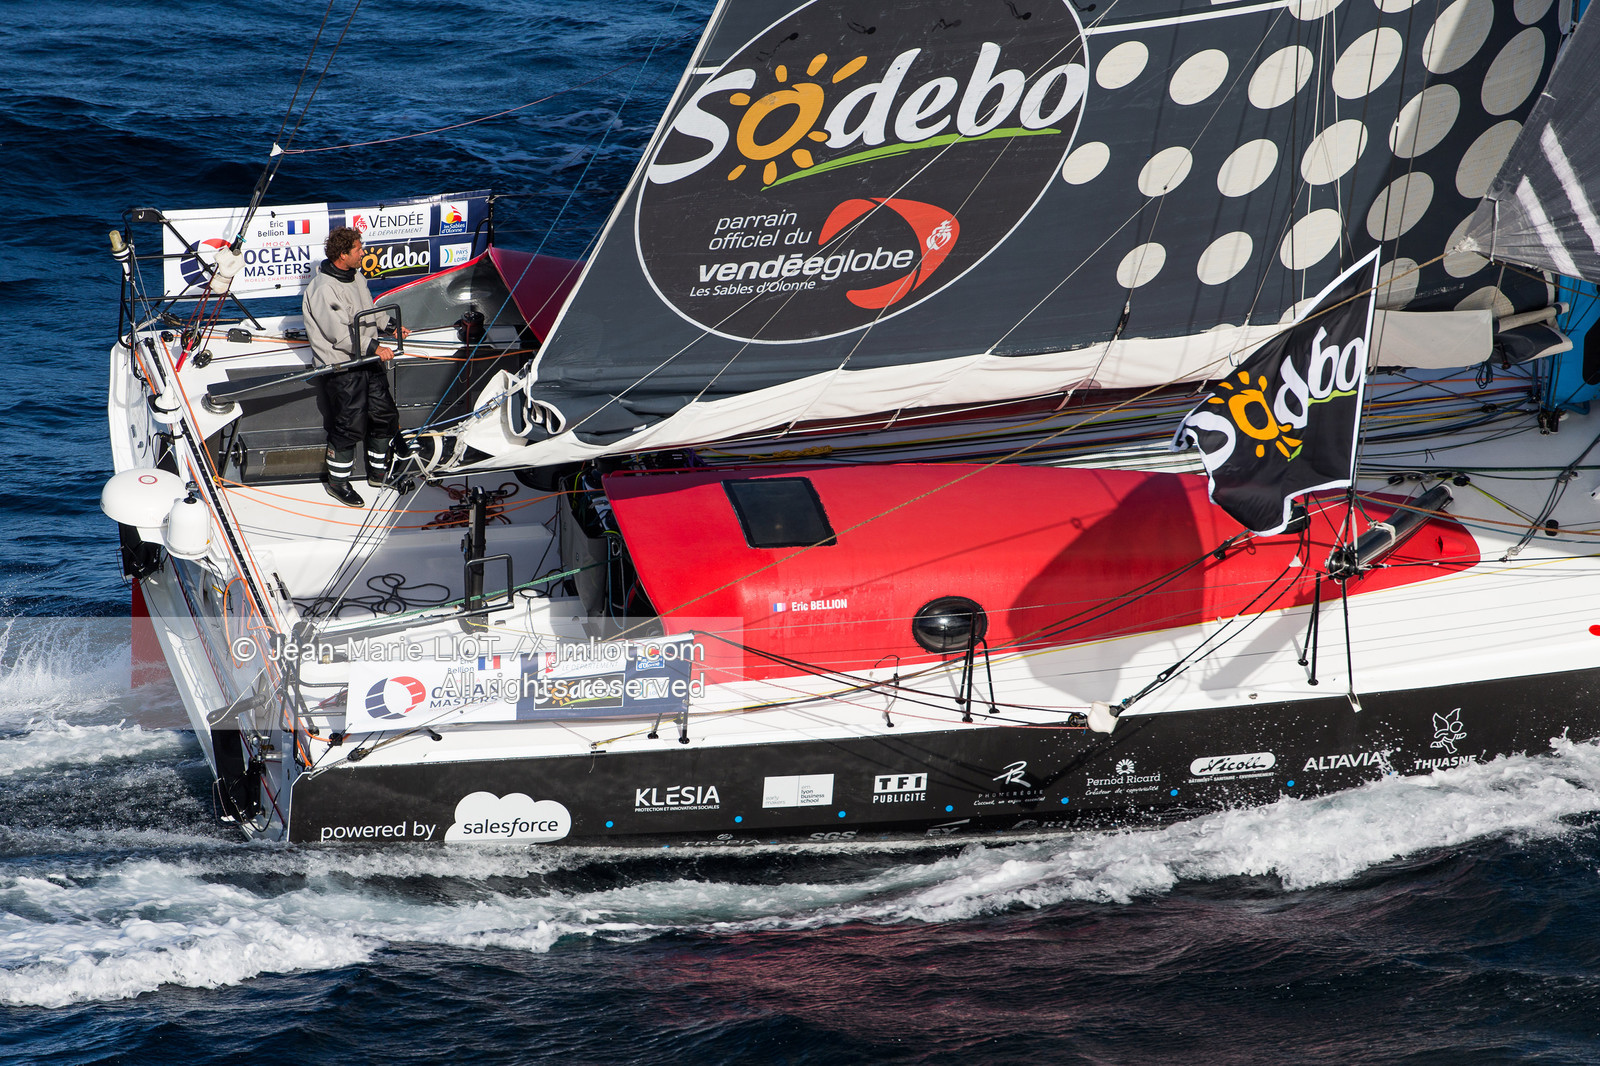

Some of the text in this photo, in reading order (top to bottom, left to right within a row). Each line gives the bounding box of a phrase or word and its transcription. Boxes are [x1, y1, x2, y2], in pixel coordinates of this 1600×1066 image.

[647, 41, 1086, 185] Sodebo
[269, 220, 284, 228] Eric
[368, 210, 424, 228] VENDÉE
[714, 209, 798, 234] parrain
[257, 229, 285, 238] Bellion
[708, 227, 812, 251] officiel du
[243, 245, 311, 265] OCEAN
[360, 244, 430, 274] odebo
[244, 262, 312, 277] MASTERS
[690, 279, 816, 297] Les Sables d'Olonne
[791, 598, 848, 612] Eric BELLION
[1198, 756, 1267, 773] Nicoll
[1302, 751, 1383, 772] ALTAVIA
[1414, 754, 1477, 770] THUASNE
[879, 776, 922, 790] TF1
[1086, 773, 1161, 787] Pernod Ricard
[635, 785, 721, 807] KLÉSIA
[872, 792, 926, 804] PUBLICITE
[320, 820, 437, 842] powered by
[463, 817, 559, 838] salesforce
[808, 831, 858, 841] SGS
